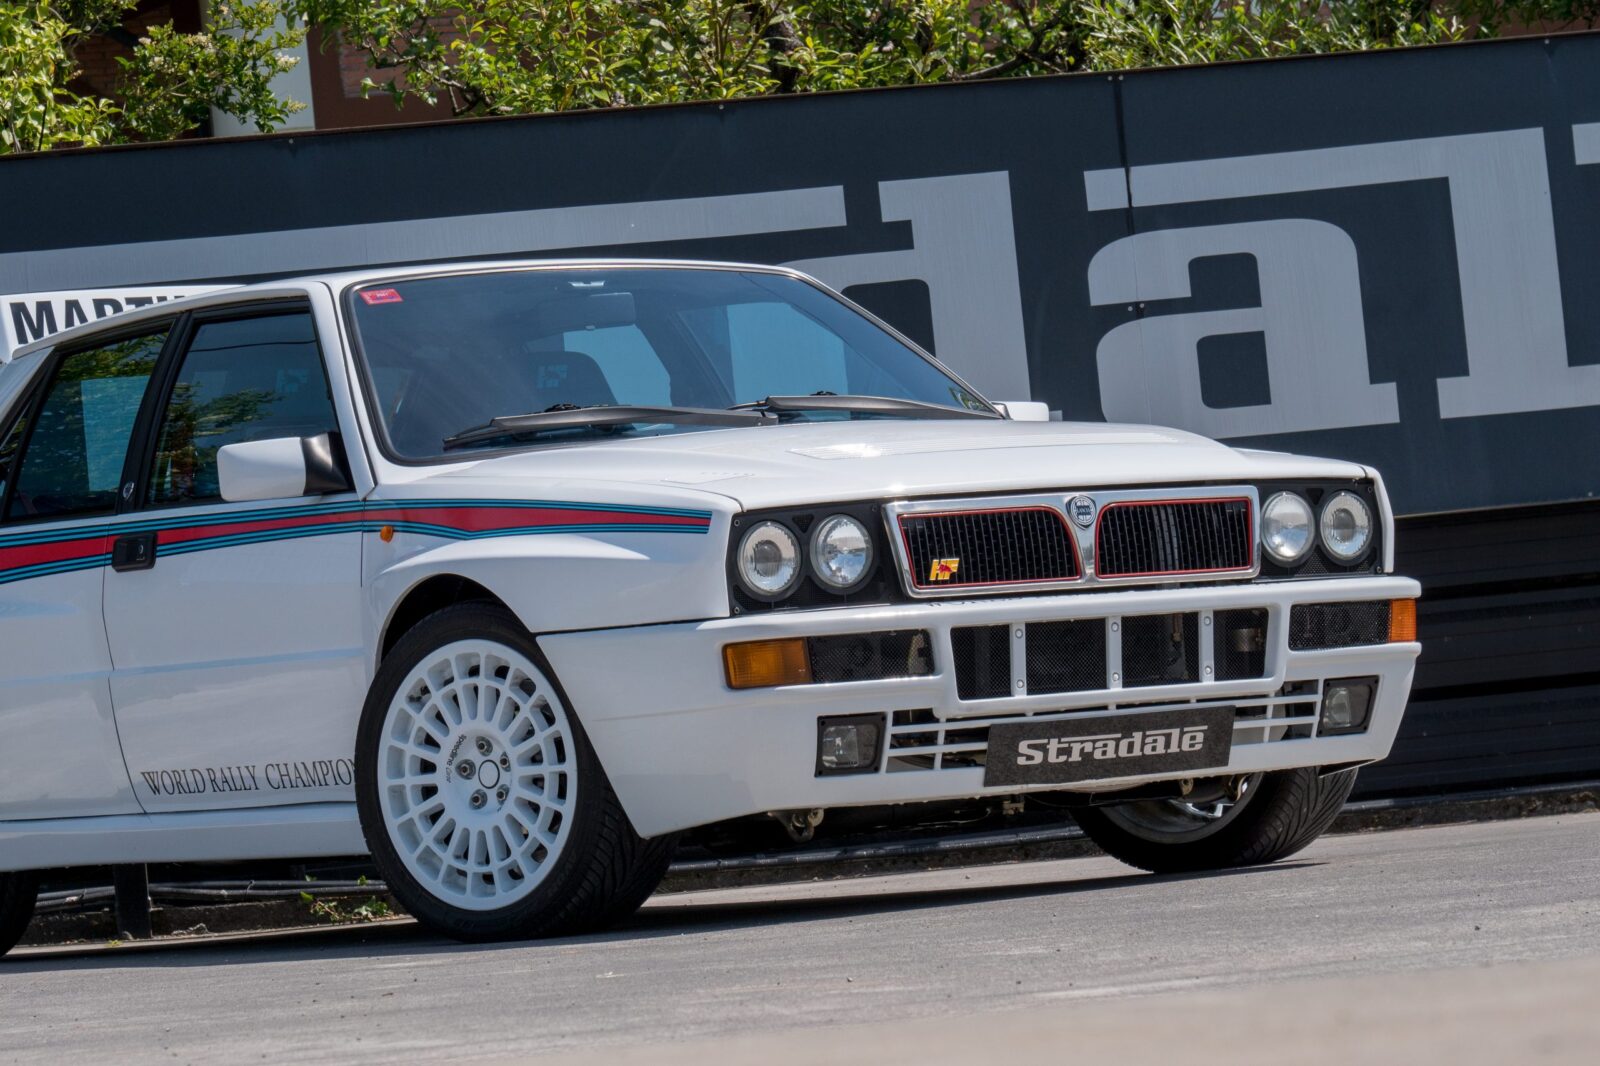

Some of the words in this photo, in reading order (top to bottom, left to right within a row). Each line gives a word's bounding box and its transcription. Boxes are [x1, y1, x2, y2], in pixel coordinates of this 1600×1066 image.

[1017, 725, 1208, 765] Stradale
[141, 768, 206, 796] WORLD
[206, 765, 260, 793] RALLY
